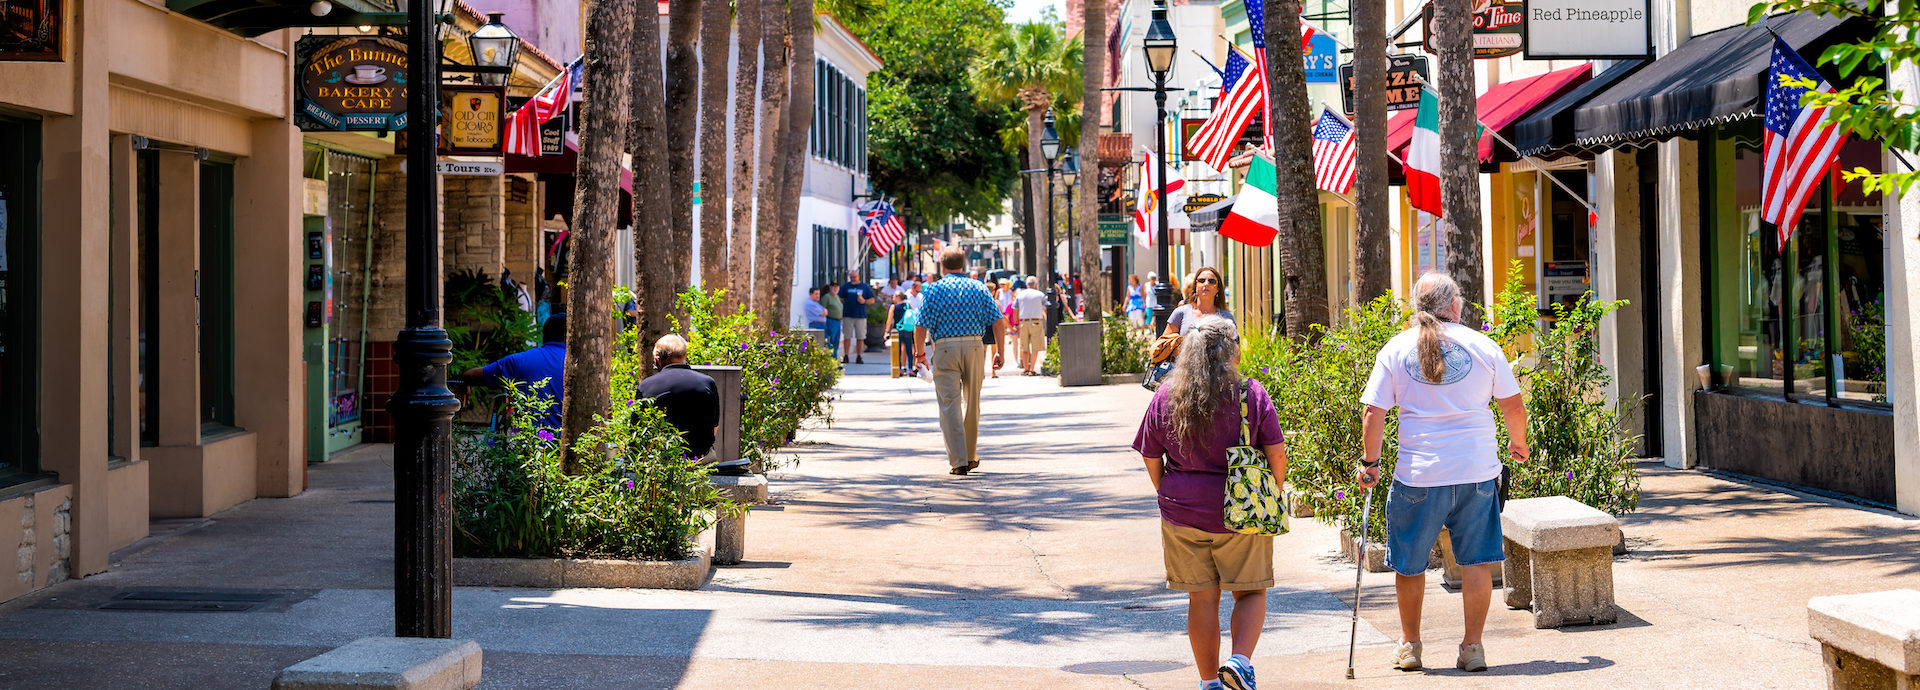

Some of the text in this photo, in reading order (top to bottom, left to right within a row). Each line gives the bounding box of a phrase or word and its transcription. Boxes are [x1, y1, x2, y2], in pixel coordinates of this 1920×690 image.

[1484, 6, 1522, 28] Time
[1532, 7, 1642, 23] Red Pineapple
[1479, 36, 1515, 45] ITALIANA
[309, 54, 346, 77] The
[318, 87, 395, 98] BAKERY
[341, 98, 392, 109] CAFE
[306, 103, 341, 128] BREAKFAST
[346, 116, 387, 125] DESSERT
[454, 111, 496, 121] OLD CITY
[456, 120, 494, 133] CIGARS
[446, 163, 481, 173] Tours
